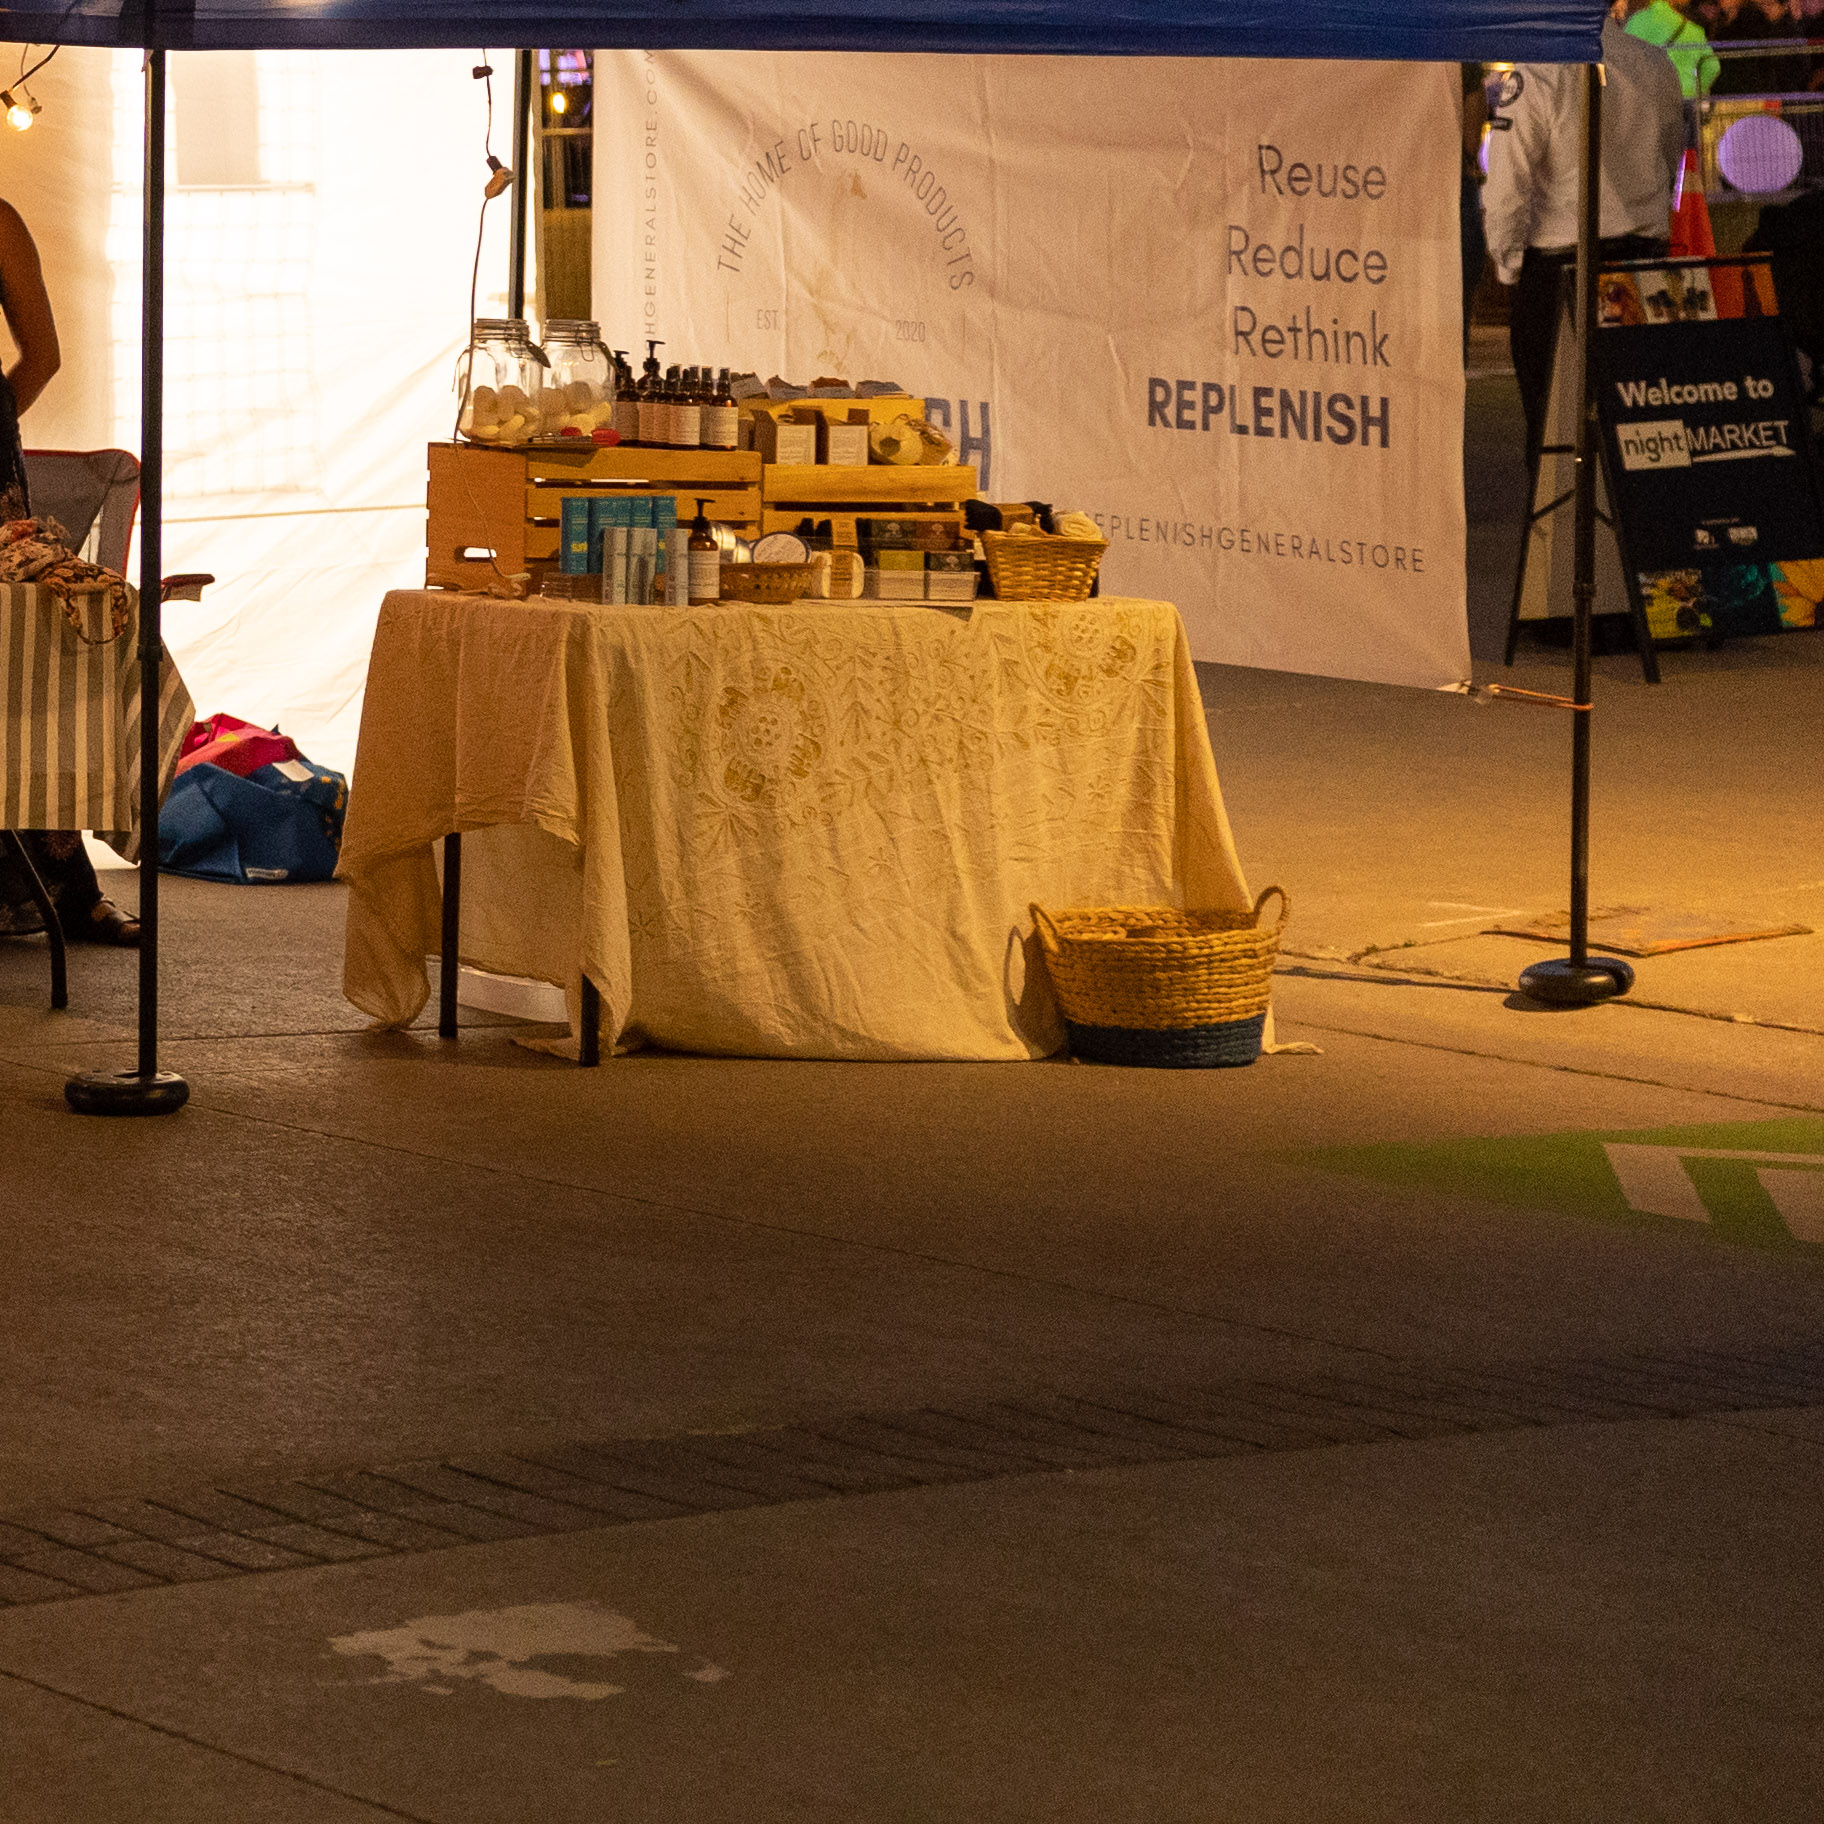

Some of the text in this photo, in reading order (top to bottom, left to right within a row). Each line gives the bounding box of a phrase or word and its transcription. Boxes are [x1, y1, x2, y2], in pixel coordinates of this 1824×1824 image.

[643, 49, 658, 352] HGENERALSTORE.COM
[1257, 143, 1387, 200] Reuse
[717, 119, 974, 291] THE HOME OF GOOD PRODUCTS
[1227, 223, 1388, 285] Reduce
[895, 319, 926, 343] 2020
[1233, 304, 1391, 368] Rethink
[1147, 376, 1390, 449] REPLENISH
[1615, 375, 1775, 408] Welcome to
[1623, 419, 1789, 463] night MARKET
[1085, 512, 1425, 574] EPLENISHGENERALSTORE
